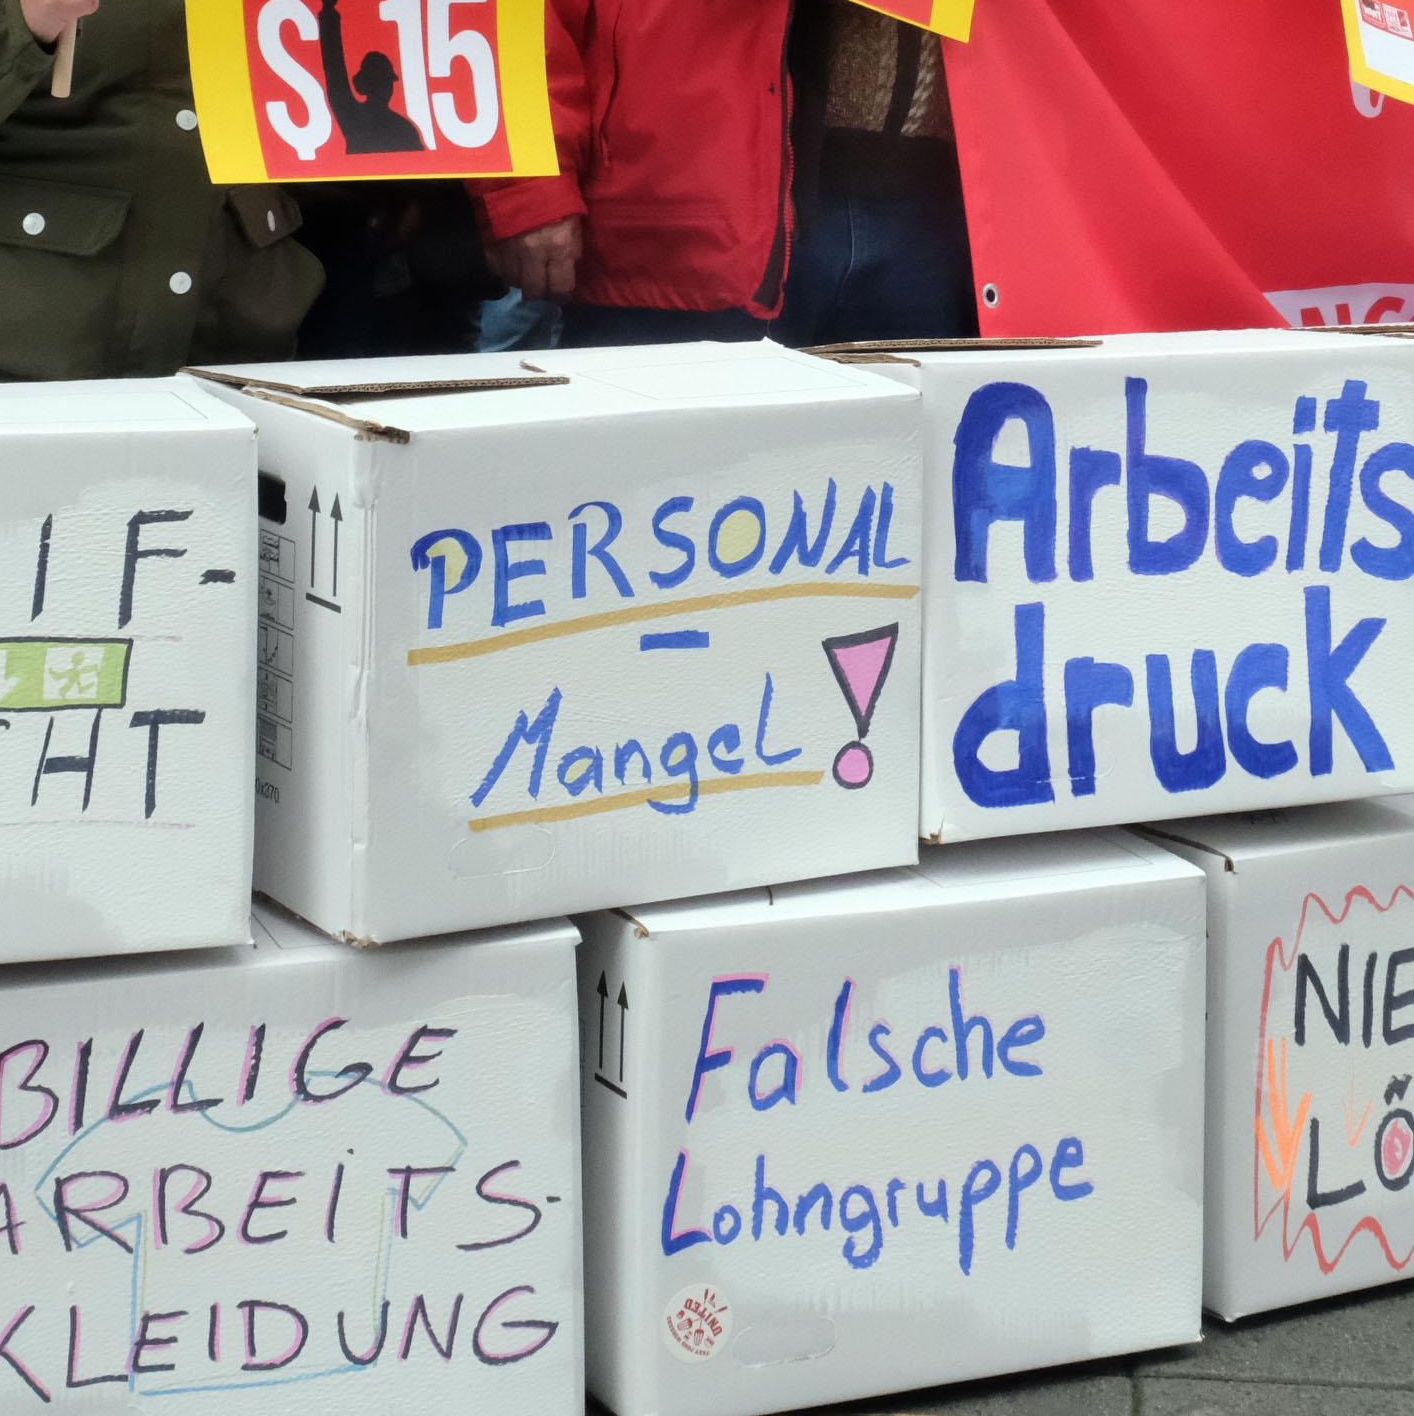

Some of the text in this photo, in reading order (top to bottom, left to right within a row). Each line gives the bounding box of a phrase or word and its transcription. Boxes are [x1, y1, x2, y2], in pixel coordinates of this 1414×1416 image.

[410, 477, 911, 629] PERSONAL
[953, 585, 1396, 808] druck
[687, 966, 1047, 1124] Falsche
[662, 1135, 1095, 1276] Lohngruppe
